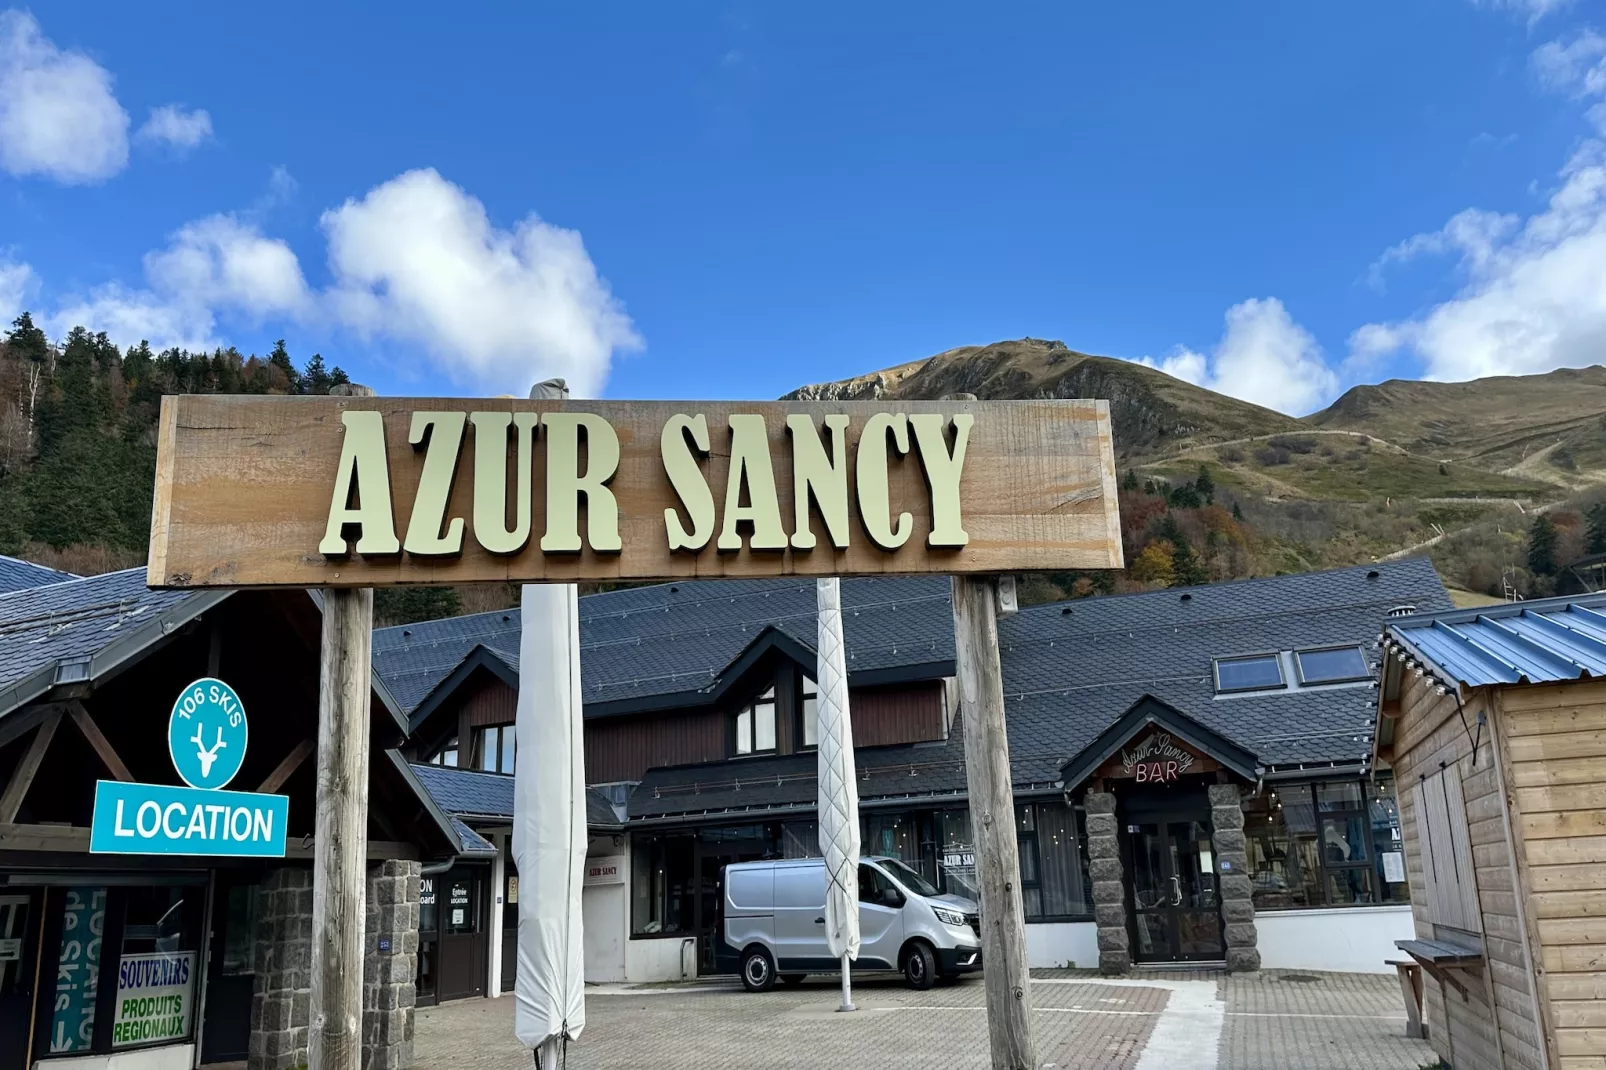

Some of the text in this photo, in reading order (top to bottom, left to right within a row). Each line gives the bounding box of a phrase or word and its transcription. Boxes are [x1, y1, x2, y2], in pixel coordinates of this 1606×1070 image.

[318, 411, 975, 556] AZUR SANCY
[178, 685, 243, 729] 106 SKIS
[1154, 733, 1194, 773] Sancy
[1136, 760, 1178, 782] BAR
[114, 799, 274, 842] LOCATION
[943, 854, 962, 866] AZUR
[419, 879, 433, 893] ON
[419, 893, 436, 905] oard
[53, 940, 82, 1013] Skis
[119, 956, 190, 990] SOUVENIRS
[121, 994, 183, 1019] PRODUITS
[113, 1016, 185, 1043] REGIONAUX
